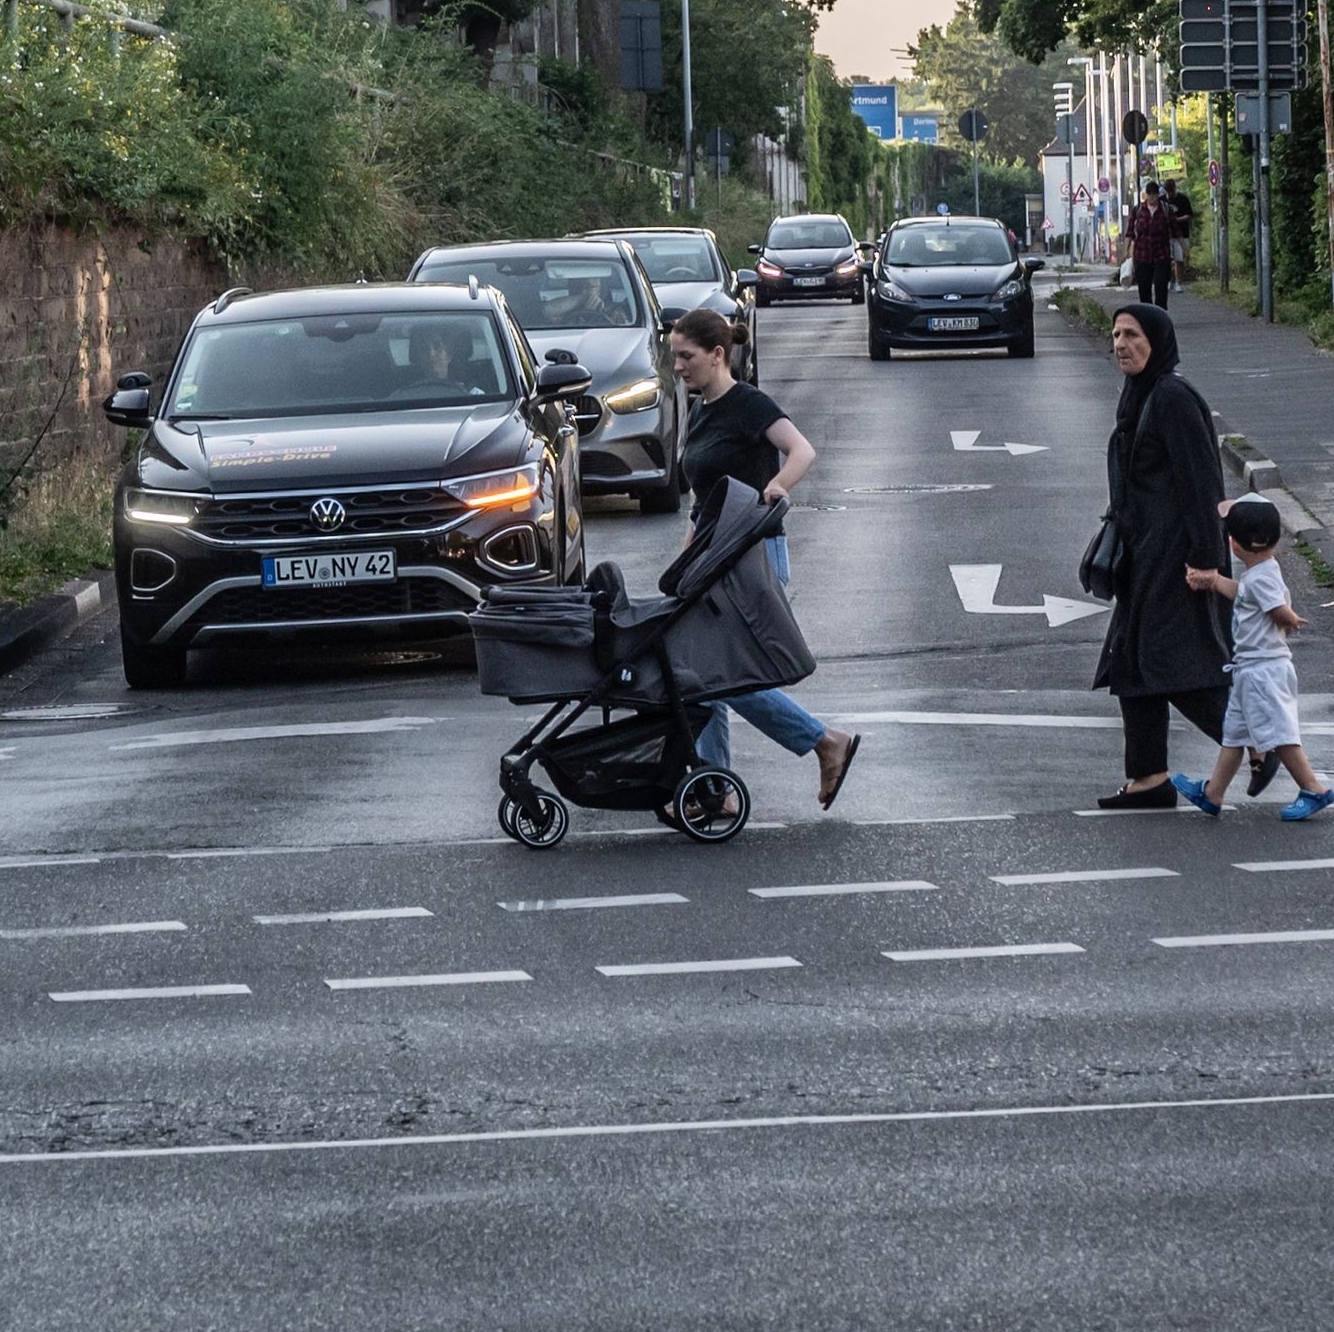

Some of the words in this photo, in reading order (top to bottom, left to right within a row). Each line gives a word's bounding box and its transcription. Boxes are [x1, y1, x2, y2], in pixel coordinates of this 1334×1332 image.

[210, 452, 331, 468] Simple-Drive
[276, 558, 318, 581] LEV
[331, 556, 359, 578] NY
[365, 554, 391, 576] 42
